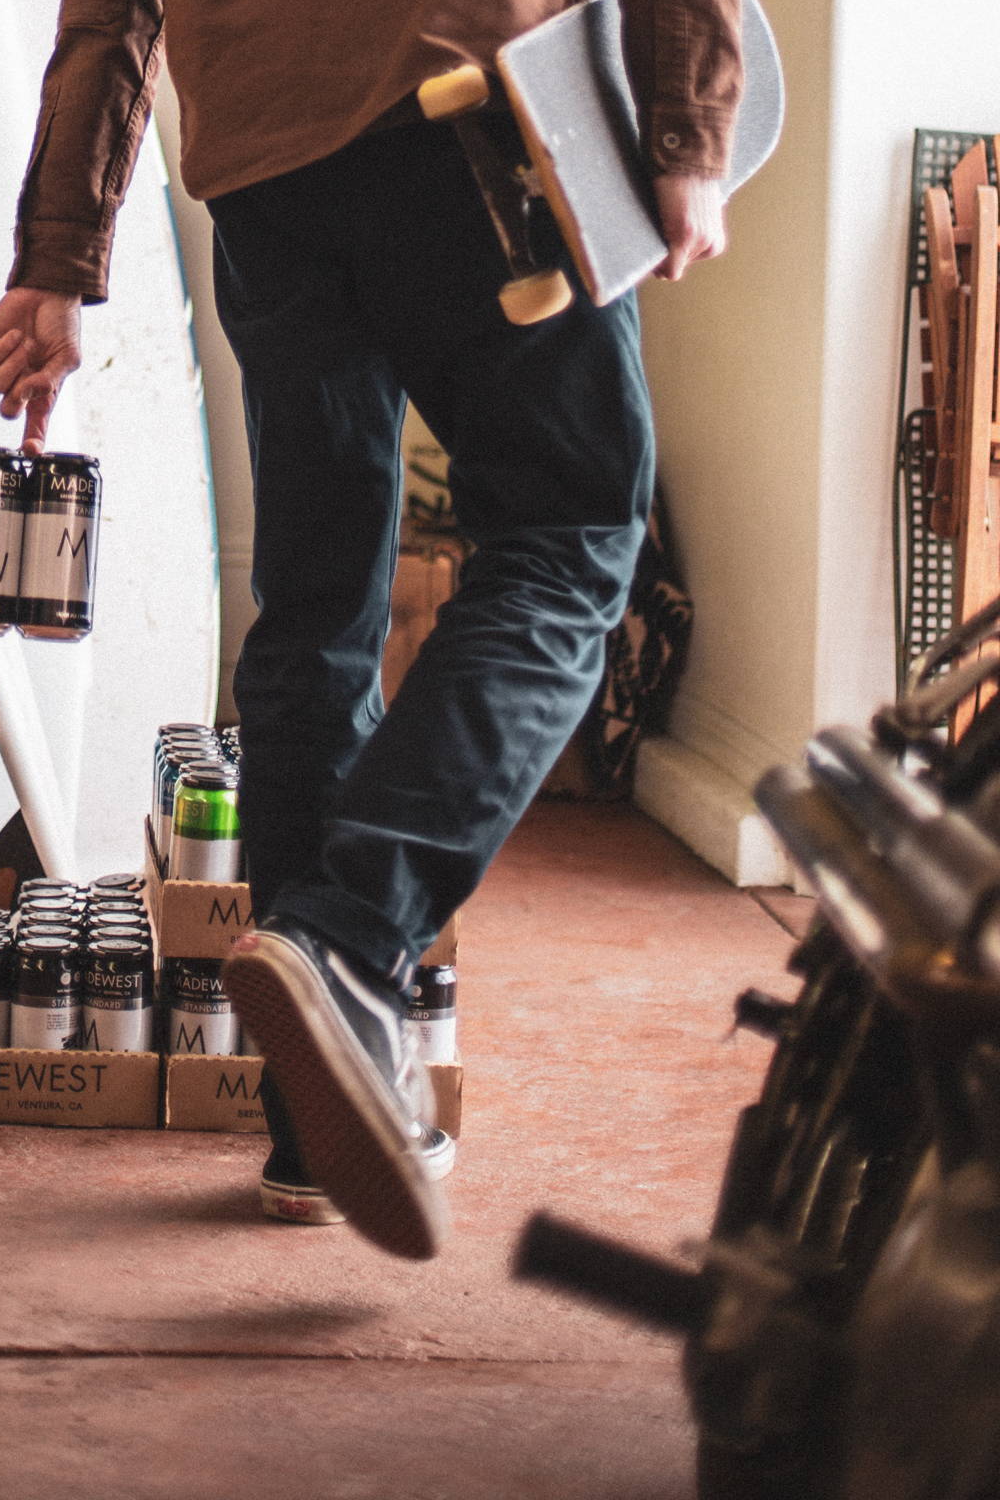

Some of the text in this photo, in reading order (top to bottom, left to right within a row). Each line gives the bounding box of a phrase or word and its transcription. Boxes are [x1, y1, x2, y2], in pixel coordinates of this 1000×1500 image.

[51, 476, 95, 494] MADE
[87, 972, 140, 989] DEWEST
[17, 1101, 64, 1111] VENTURA,
[68, 1102, 83, 1111] CA
